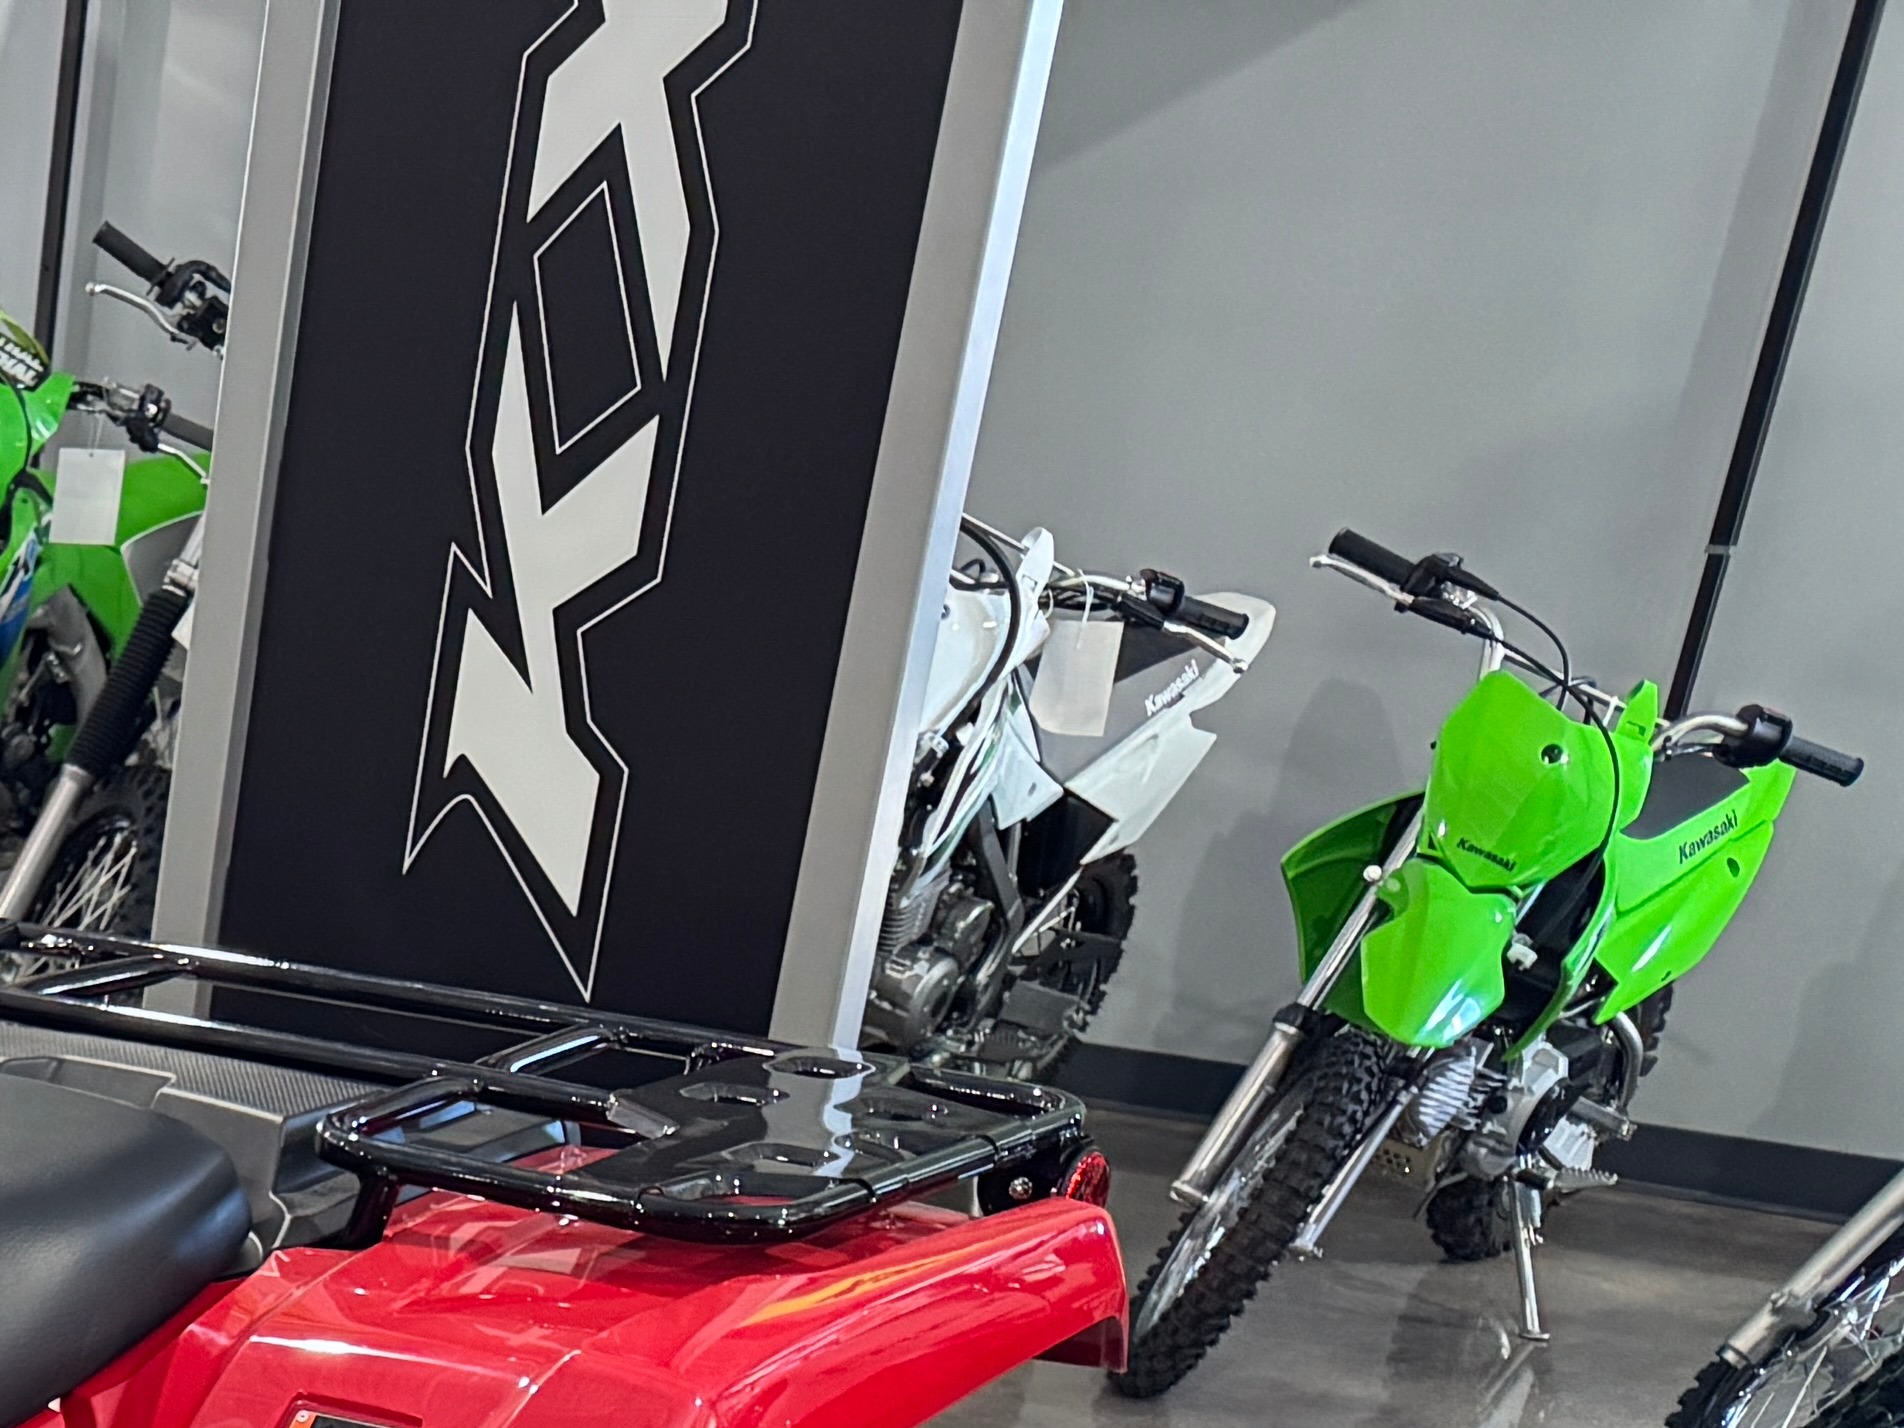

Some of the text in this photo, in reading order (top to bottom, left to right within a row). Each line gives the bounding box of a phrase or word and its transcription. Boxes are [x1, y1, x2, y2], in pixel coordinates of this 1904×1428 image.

[1144, 658, 1200, 718] Kawasaki
[1456, 837, 1518, 873] Kawasaki
[1678, 808, 1739, 865] Kawasaki
